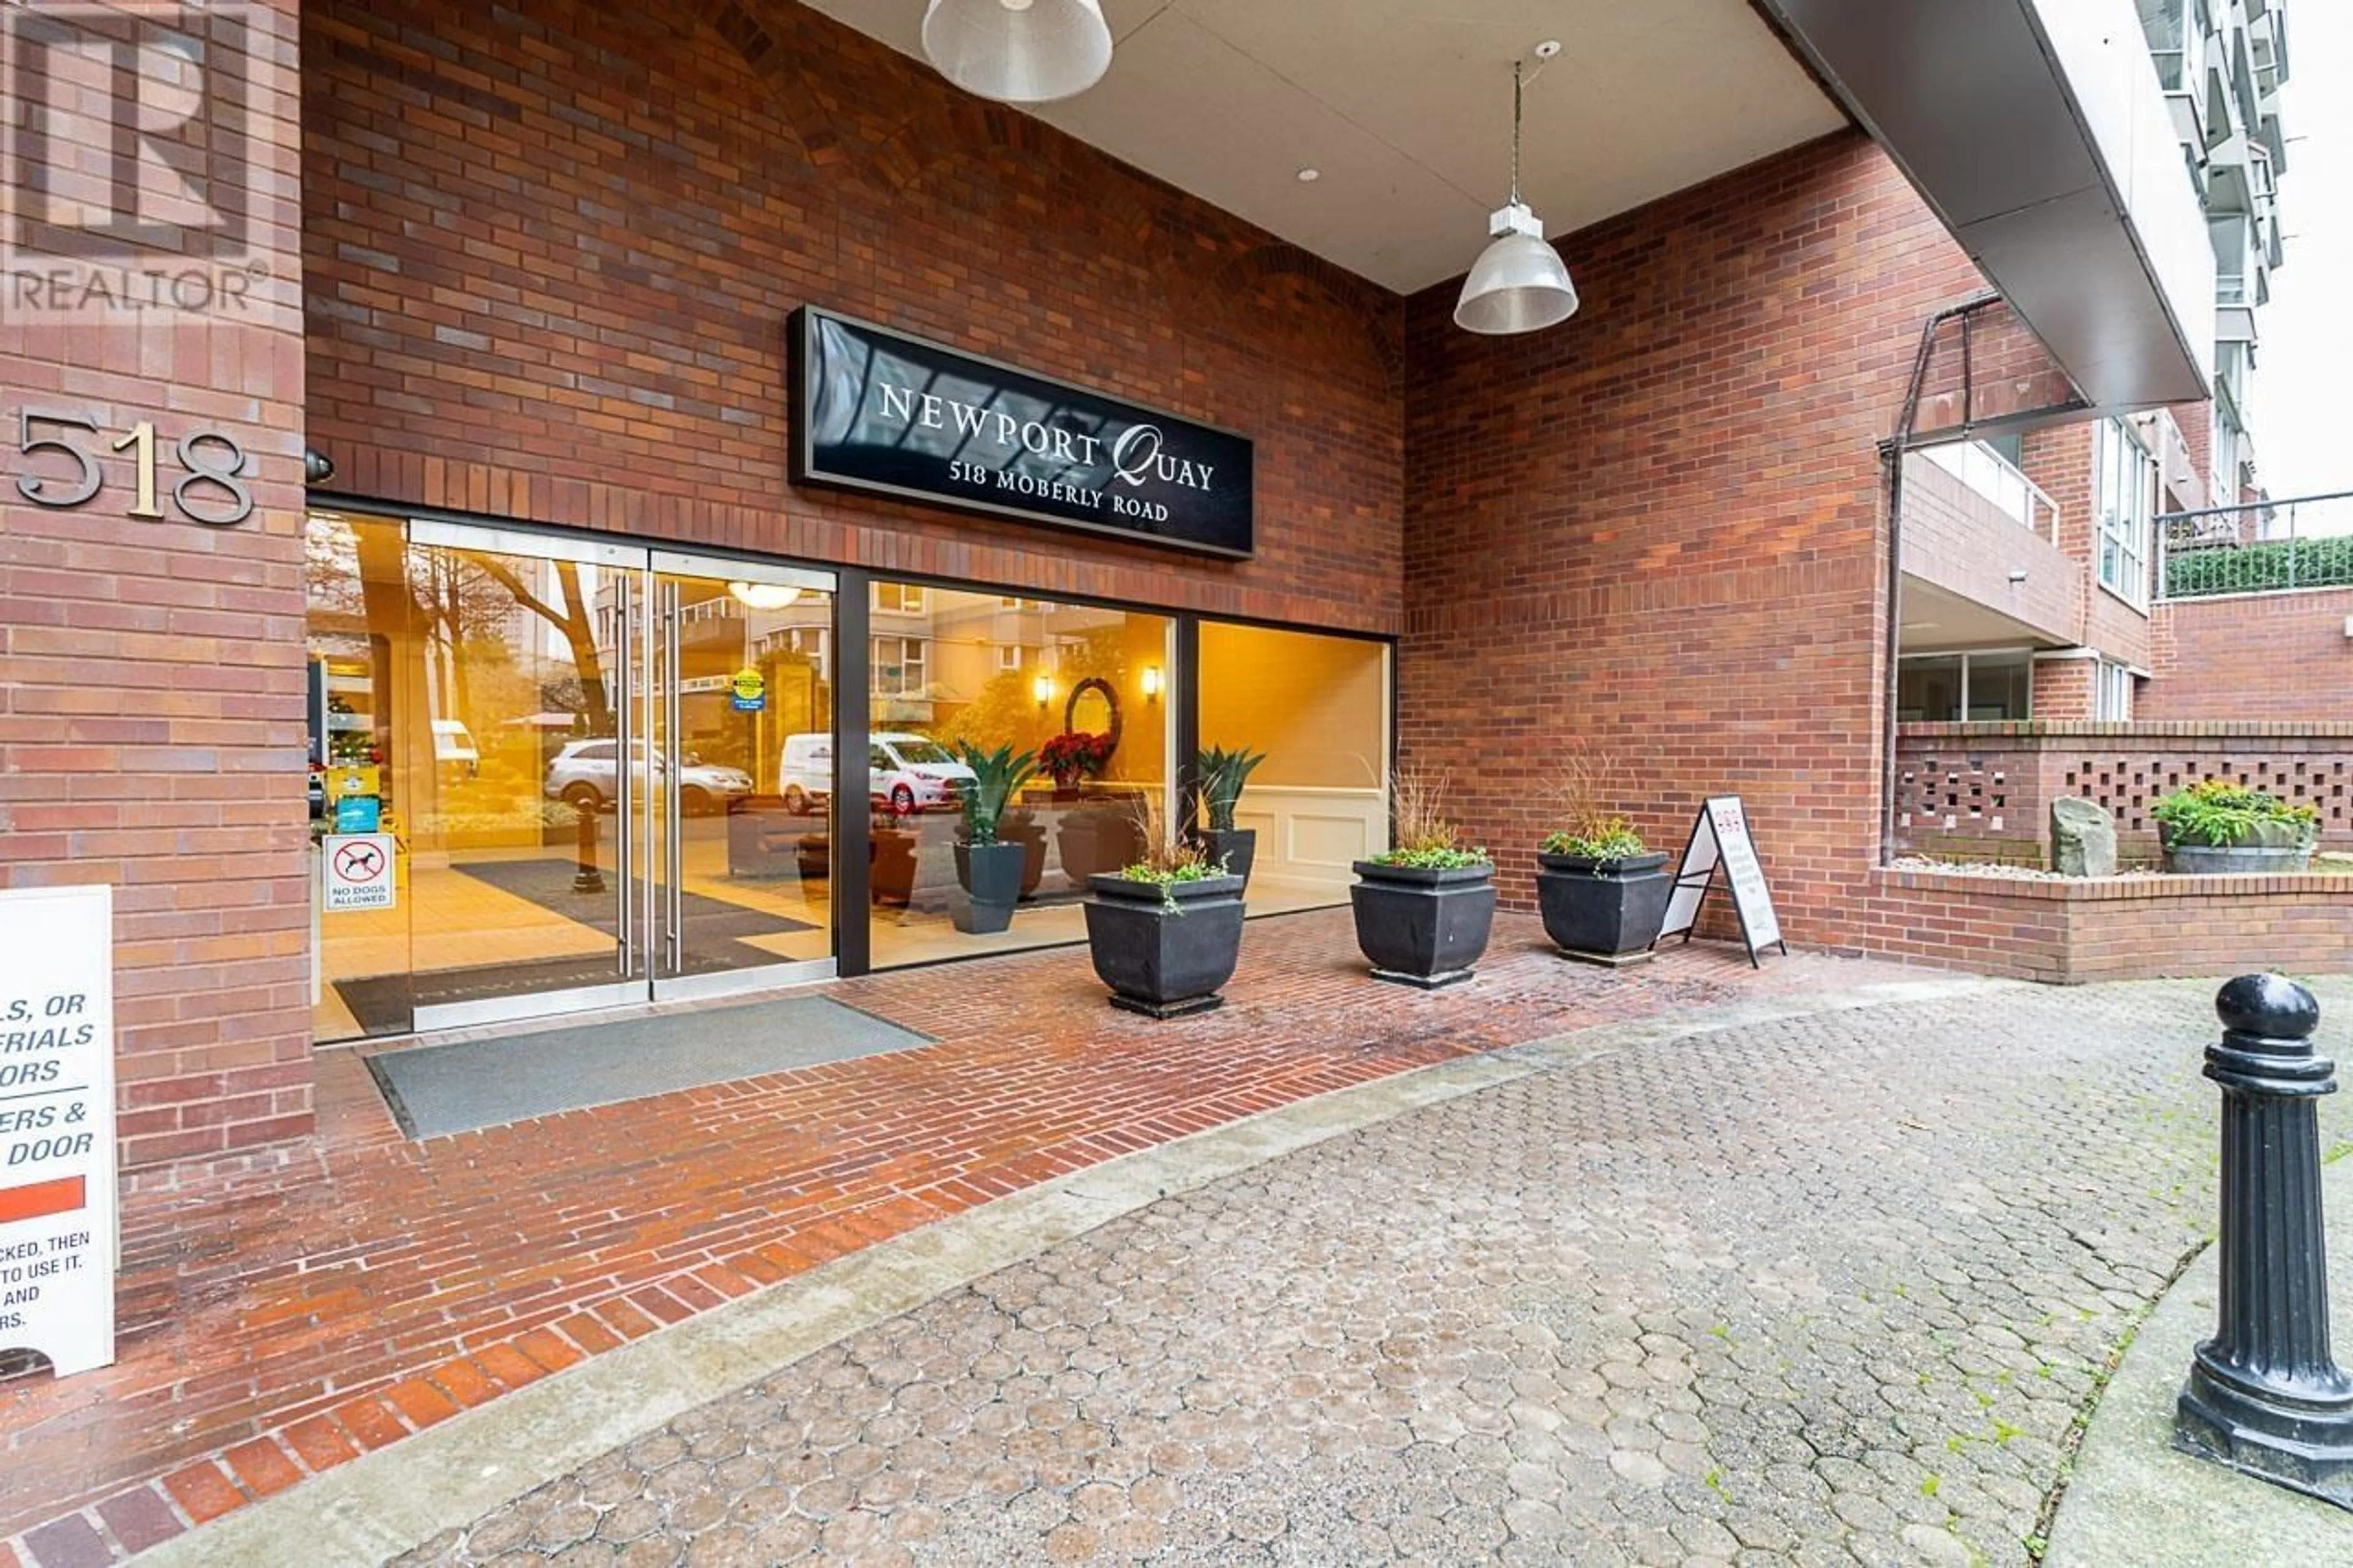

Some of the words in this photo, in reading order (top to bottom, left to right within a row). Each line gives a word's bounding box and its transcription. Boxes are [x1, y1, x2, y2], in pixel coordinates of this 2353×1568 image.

[879, 382, 1101, 466] NEWPORT
[1113, 423, 1214, 491] QUAY
[16, 404, 254, 525] 518
[949, 460, 987, 485] 518
[996, 471, 1103, 509] MOBERLY
[1113, 494, 1169, 523] ROAD
[333, 886, 350, 896] NO
[353, 885, 385, 895] DOGS
[335, 895, 385, 904] ALLOWED
[45, 994, 86, 1017] OR
[64, 1102, 86, 1124] &
[7, 1132, 94, 1165] DOOR
[47, 1231, 89, 1251] THEN
[2, 1267, 22, 1284] TO
[28, 1259, 59, 1279] USE
[66, 1254, 83, 1272] IT.
[4, 1286, 40, 1307] AND
